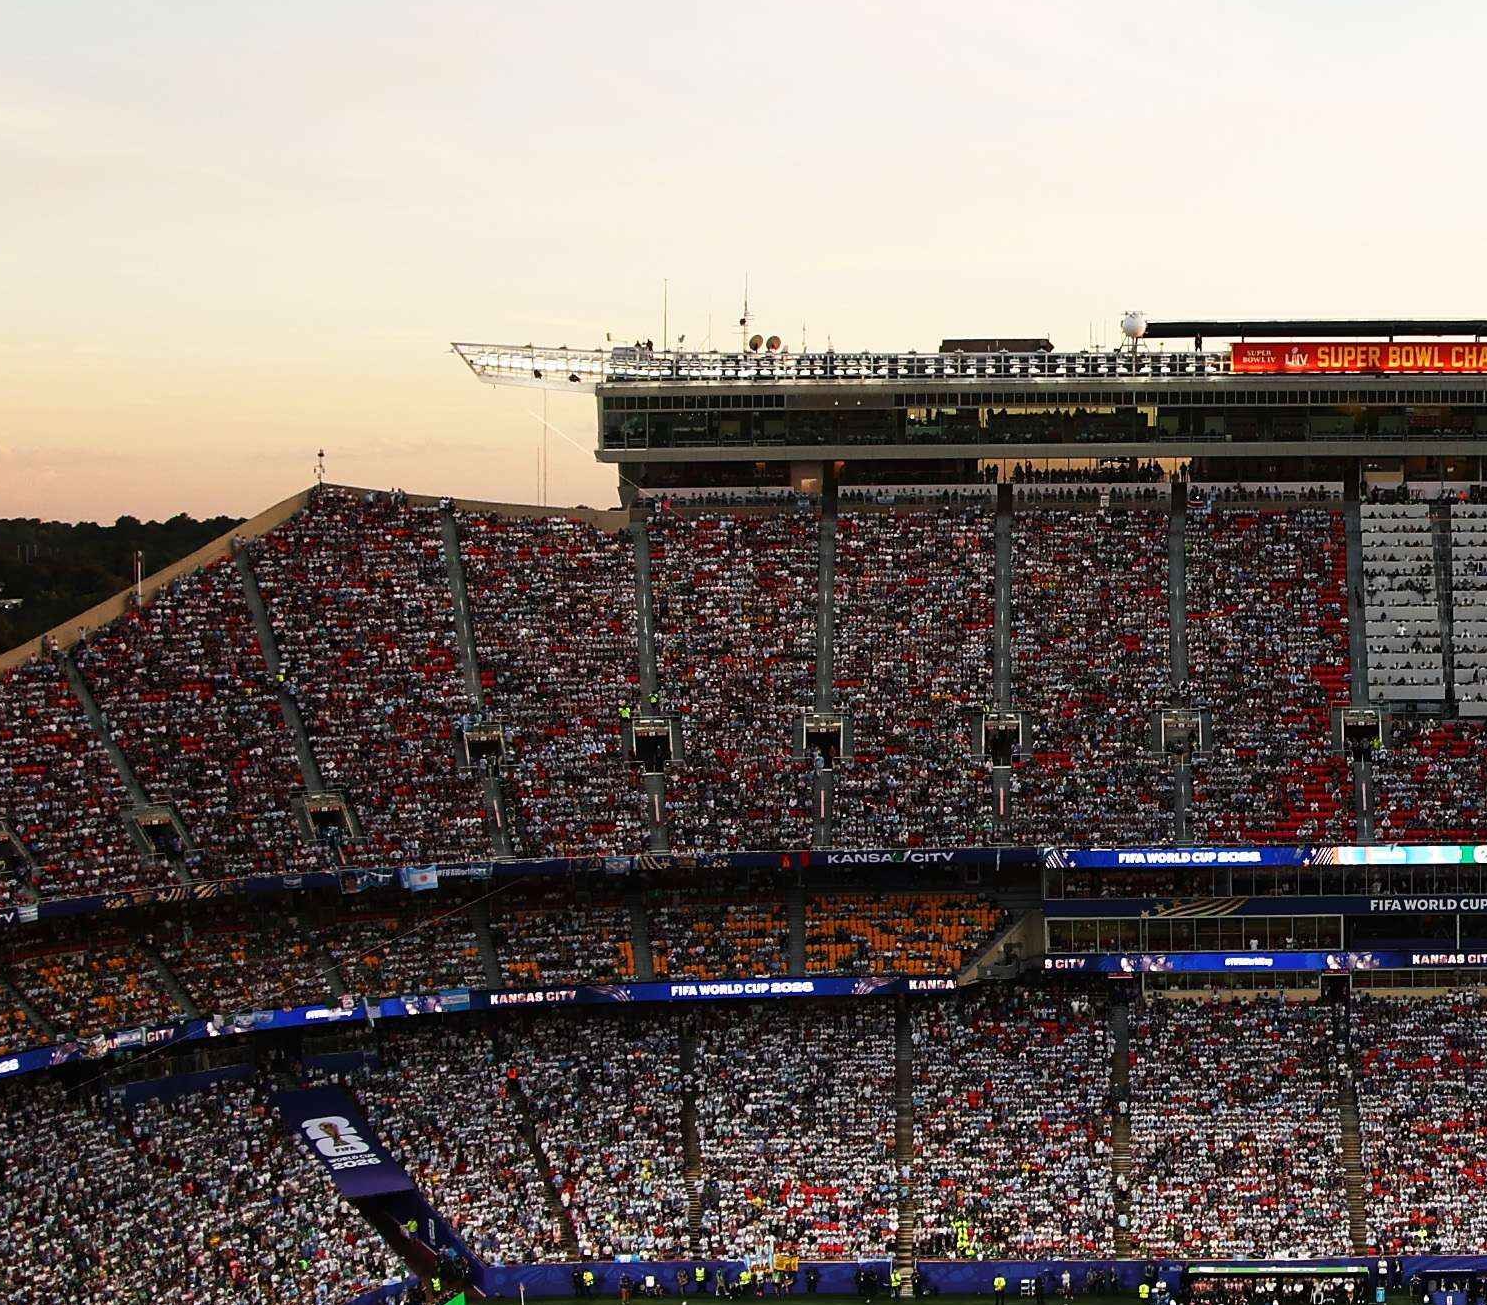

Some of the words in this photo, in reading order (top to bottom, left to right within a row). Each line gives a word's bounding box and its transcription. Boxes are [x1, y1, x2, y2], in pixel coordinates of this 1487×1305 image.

[1317, 347, 1380, 367] SUPER
[1388, 347, 1444, 367] BOWL
[1119, 852, 1145, 863] FIFA
[1146, 852, 1191, 863] WORLD
[1192, 852, 1216, 863] CUP
[1370, 899, 1403, 910] FIFA
[1404, 899, 1459, 910] WORLD
[1055, 958, 1086, 968] CITY
[1412, 954, 1465, 965] KANSAS
[671, 986, 697, 996] FIFA
[699, 984, 743, 995] WORLD
[745, 983, 770, 994] CUP
[491, 992, 543, 1004] KANSAS
[546, 990, 577, 1001] CITY
[328, 1154, 359, 1163] WORLD
[331, 1158, 381, 1170] 2026
